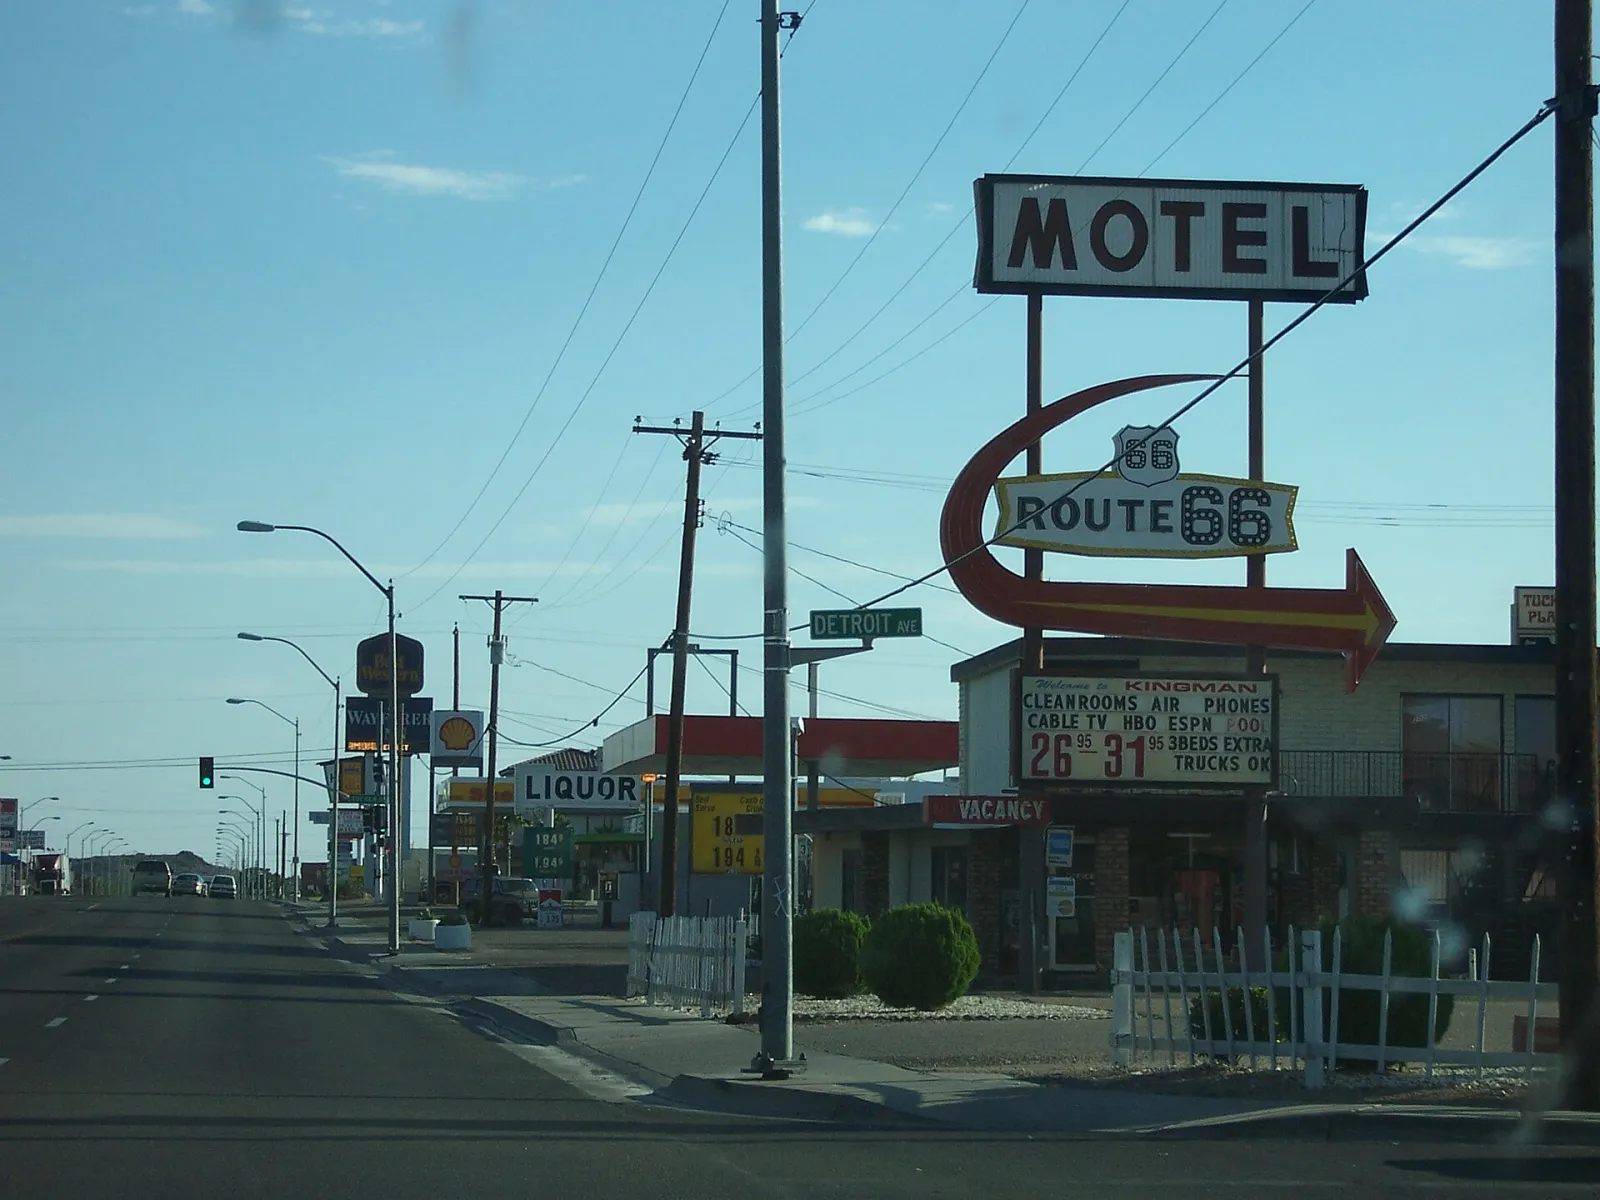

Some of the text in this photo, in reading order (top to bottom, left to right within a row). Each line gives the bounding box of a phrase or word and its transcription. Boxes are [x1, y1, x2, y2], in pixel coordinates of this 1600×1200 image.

[1006, 196, 1340, 278] MOTEL
[1124, 438, 1173, 470] 66
[1015, 485, 1272, 547] ROUTE 66
[814, 613, 918, 635] DETROIT AVE
[359, 664, 418, 682] Wesern
[1035, 678, 1258, 693] Welcome to KINGMAN
[1151, 696, 1181, 713] AIR
[1204, 697, 1270, 713] PHONES
[348, 710, 430, 726] WAYFRER
[1027, 713, 1079, 729] CABLE
[1086, 714, 1108, 730] TV
[1123, 715, 1157, 731] HBO
[1168, 716, 1212, 732] ESPN
[1031, 732, 1072, 778] 26
[1104, 733, 1145, 778] 31
[1223, 737, 1271, 752] EXTRA
[1173, 754, 1271, 772] TRUCKS OK
[526, 775, 637, 801] LIQUOR
[959, 799, 1045, 820] VACANCY
[713, 845, 745, 868] 194
